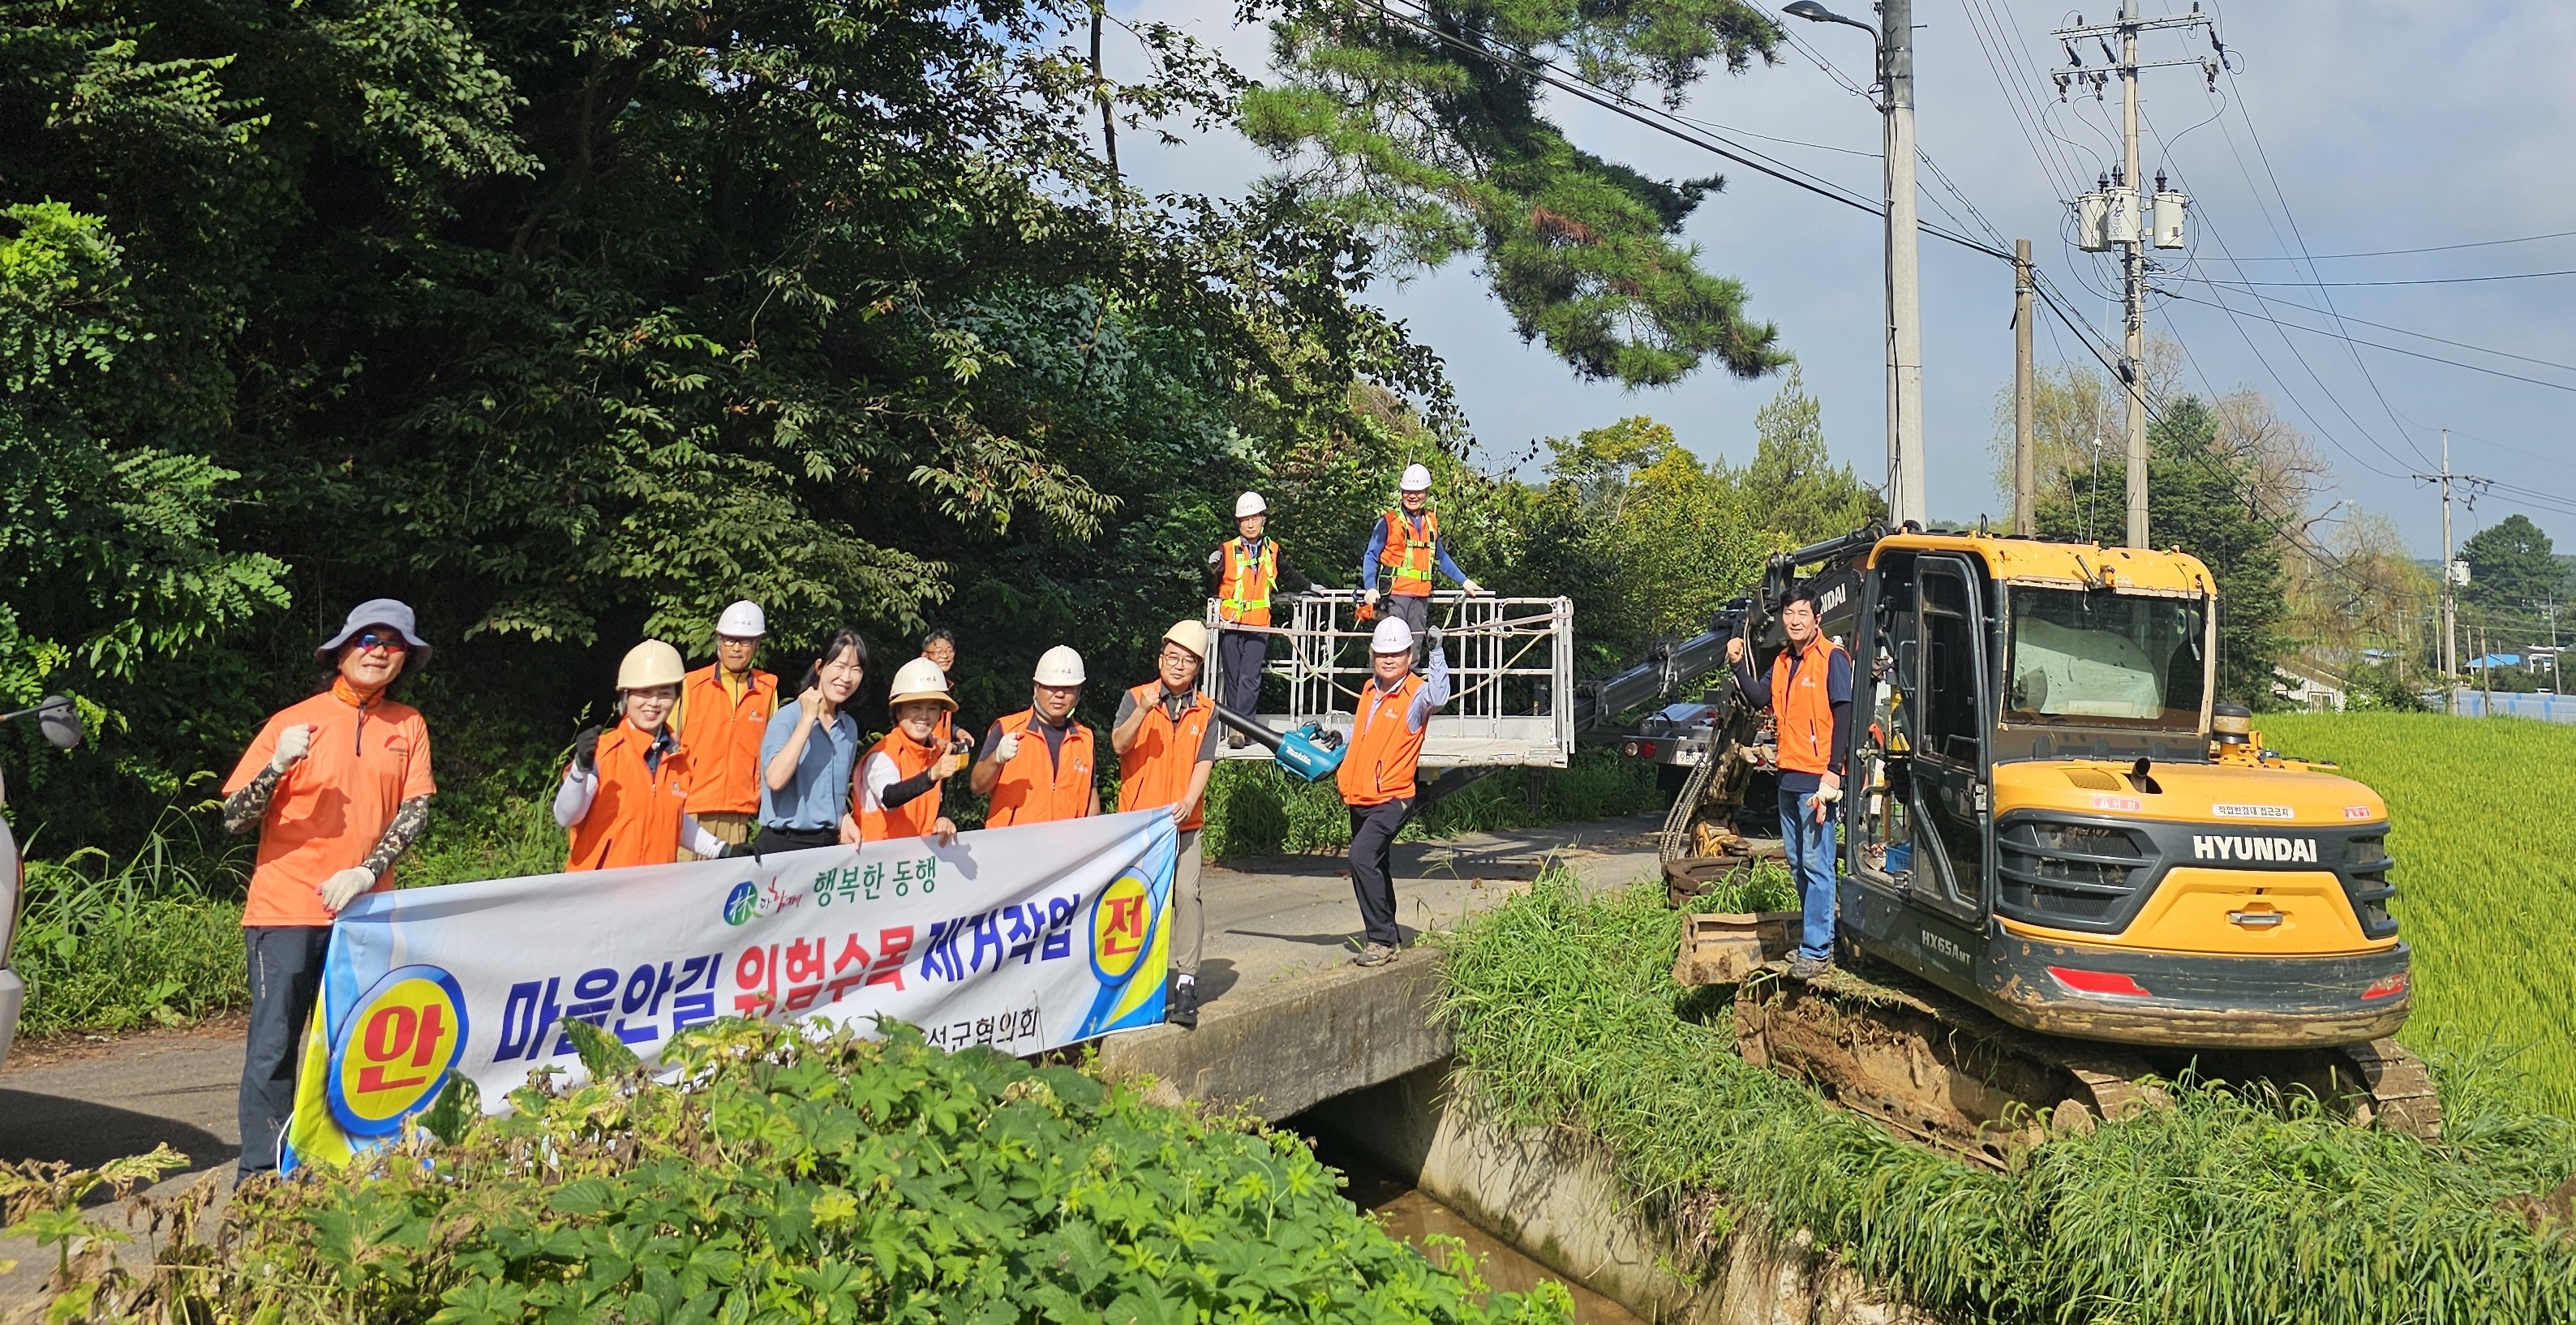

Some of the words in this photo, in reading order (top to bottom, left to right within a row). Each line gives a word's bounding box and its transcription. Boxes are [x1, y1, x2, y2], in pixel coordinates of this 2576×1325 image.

[1820, 582, 1846, 615] NDAI
[2193, 834, 2318, 863] HYUNDAI
[814, 862, 886, 907] 행복한
[893, 855, 937, 897] 동행
[1102, 894, 1144, 957] 전
[492, 951, 724, 1063] 마을안길
[734, 924, 915, 1018] 위험수목
[920, 893, 1081, 983] 제거작업
[356, 1003, 446, 1094] 안
